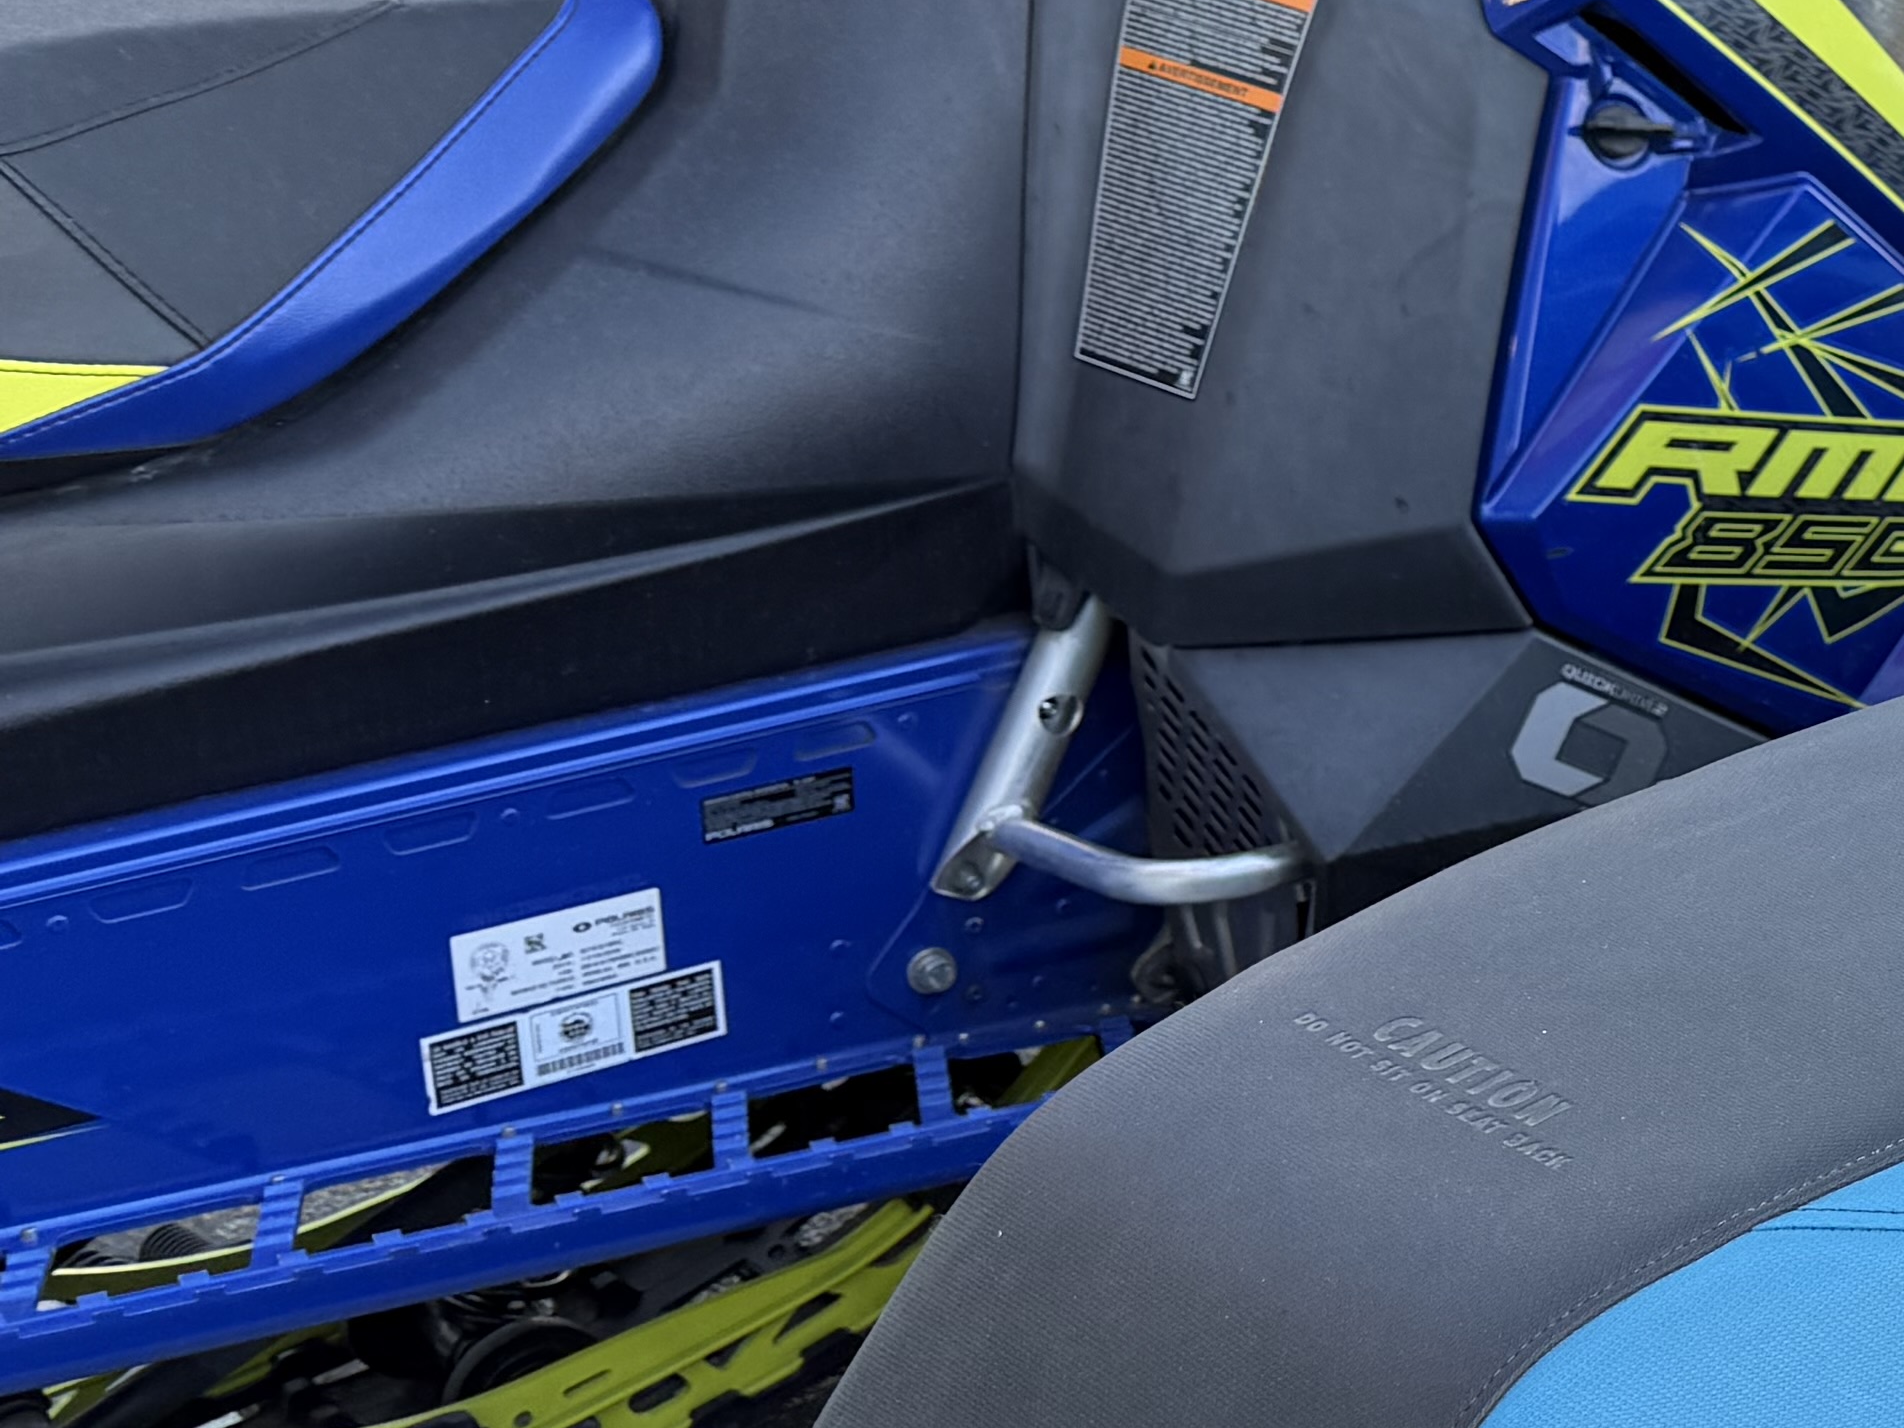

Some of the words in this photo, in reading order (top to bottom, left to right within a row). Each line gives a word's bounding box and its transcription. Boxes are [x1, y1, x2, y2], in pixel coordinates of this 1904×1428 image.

[1294, 1011, 1329, 1032] DO
[1325, 1029, 1375, 1059] NOT
[1369, 1058, 1413, 1081] SIT
[1409, 1081, 1450, 1103] ON
[1445, 1100, 1511, 1134] SEAT
[1373, 1015, 1573, 1127] CAUTION
